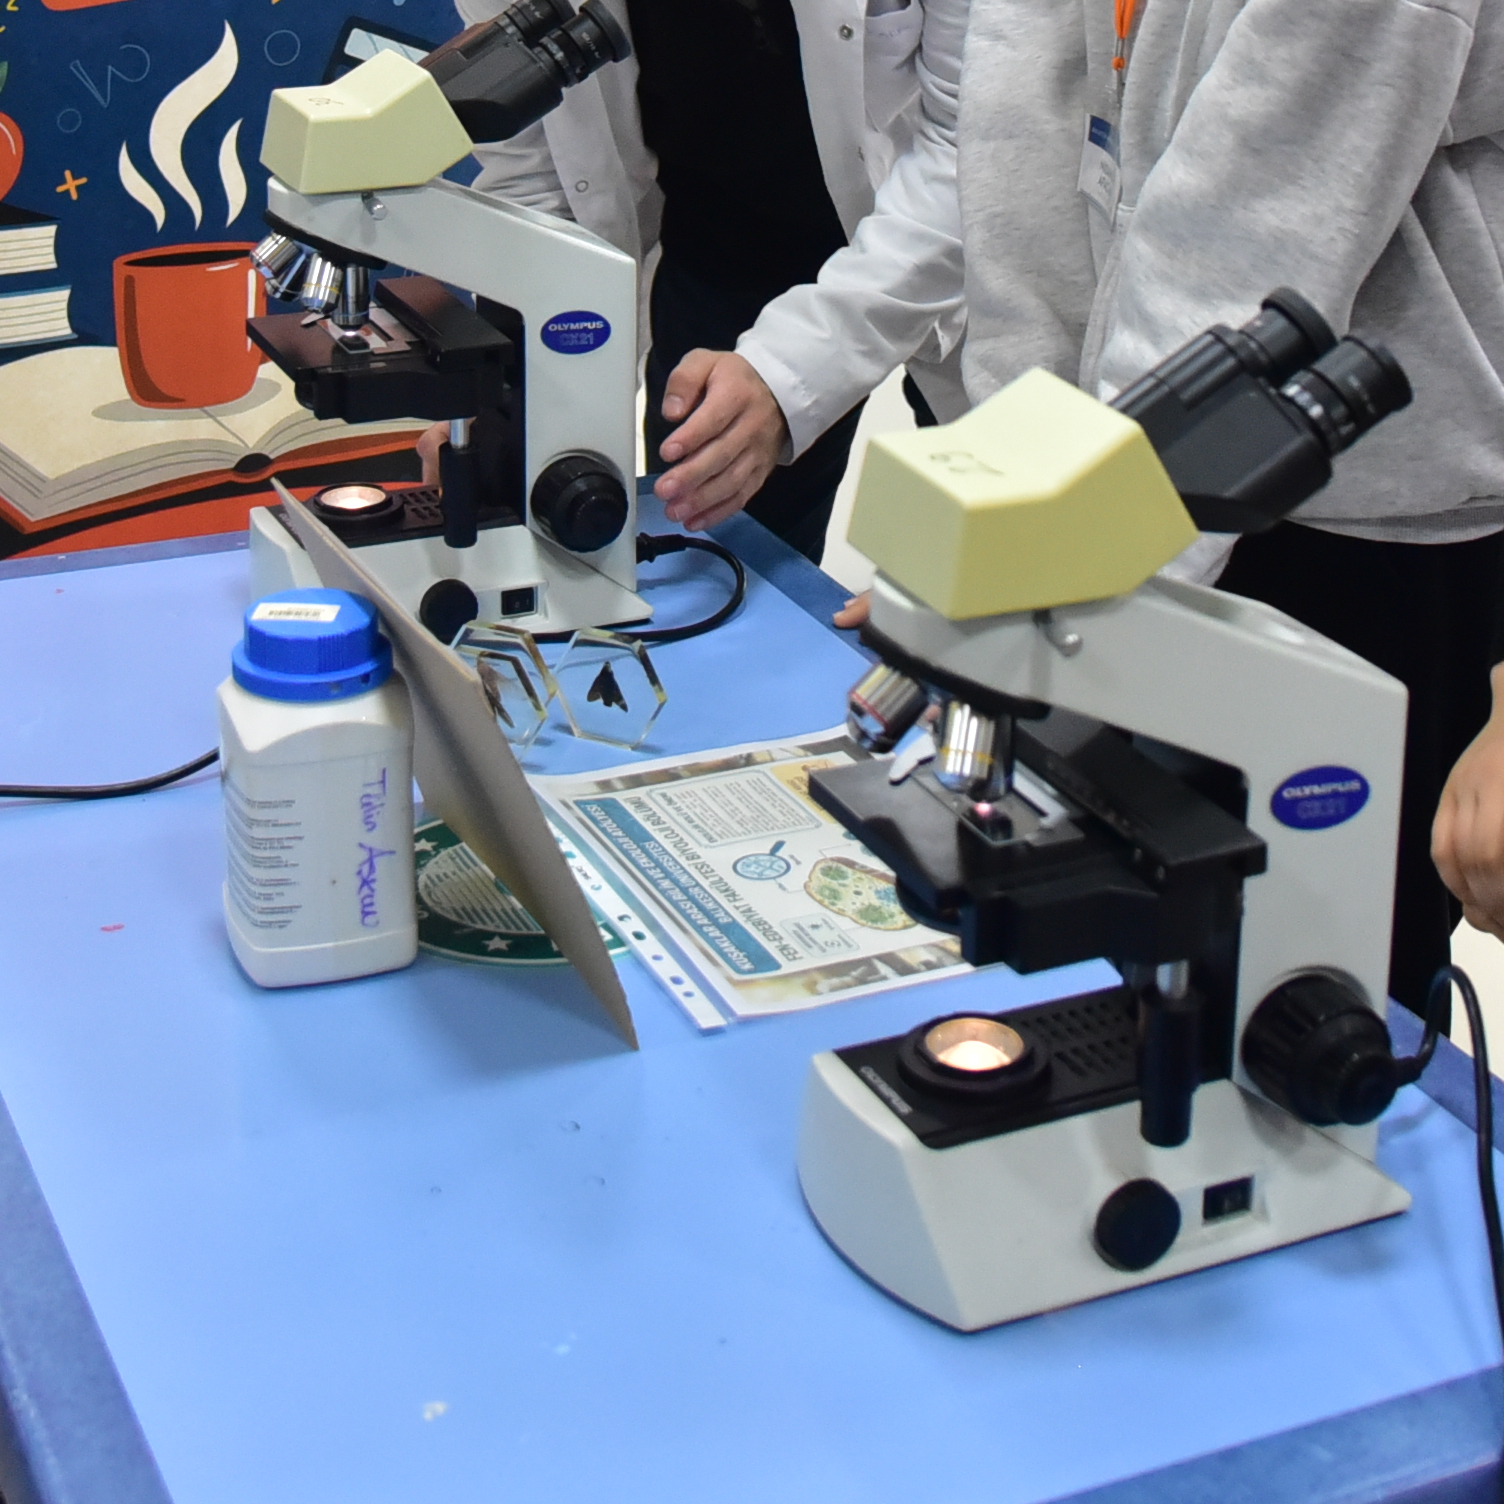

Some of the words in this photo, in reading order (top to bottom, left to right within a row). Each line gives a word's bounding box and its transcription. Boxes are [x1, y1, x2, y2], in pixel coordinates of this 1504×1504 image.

[548, 320, 604, 332] OLYMPUS
[688, 861, 743, 903] FAKÜLTESİ
[734, 904, 803, 961] FEN-EDEBİYAT
